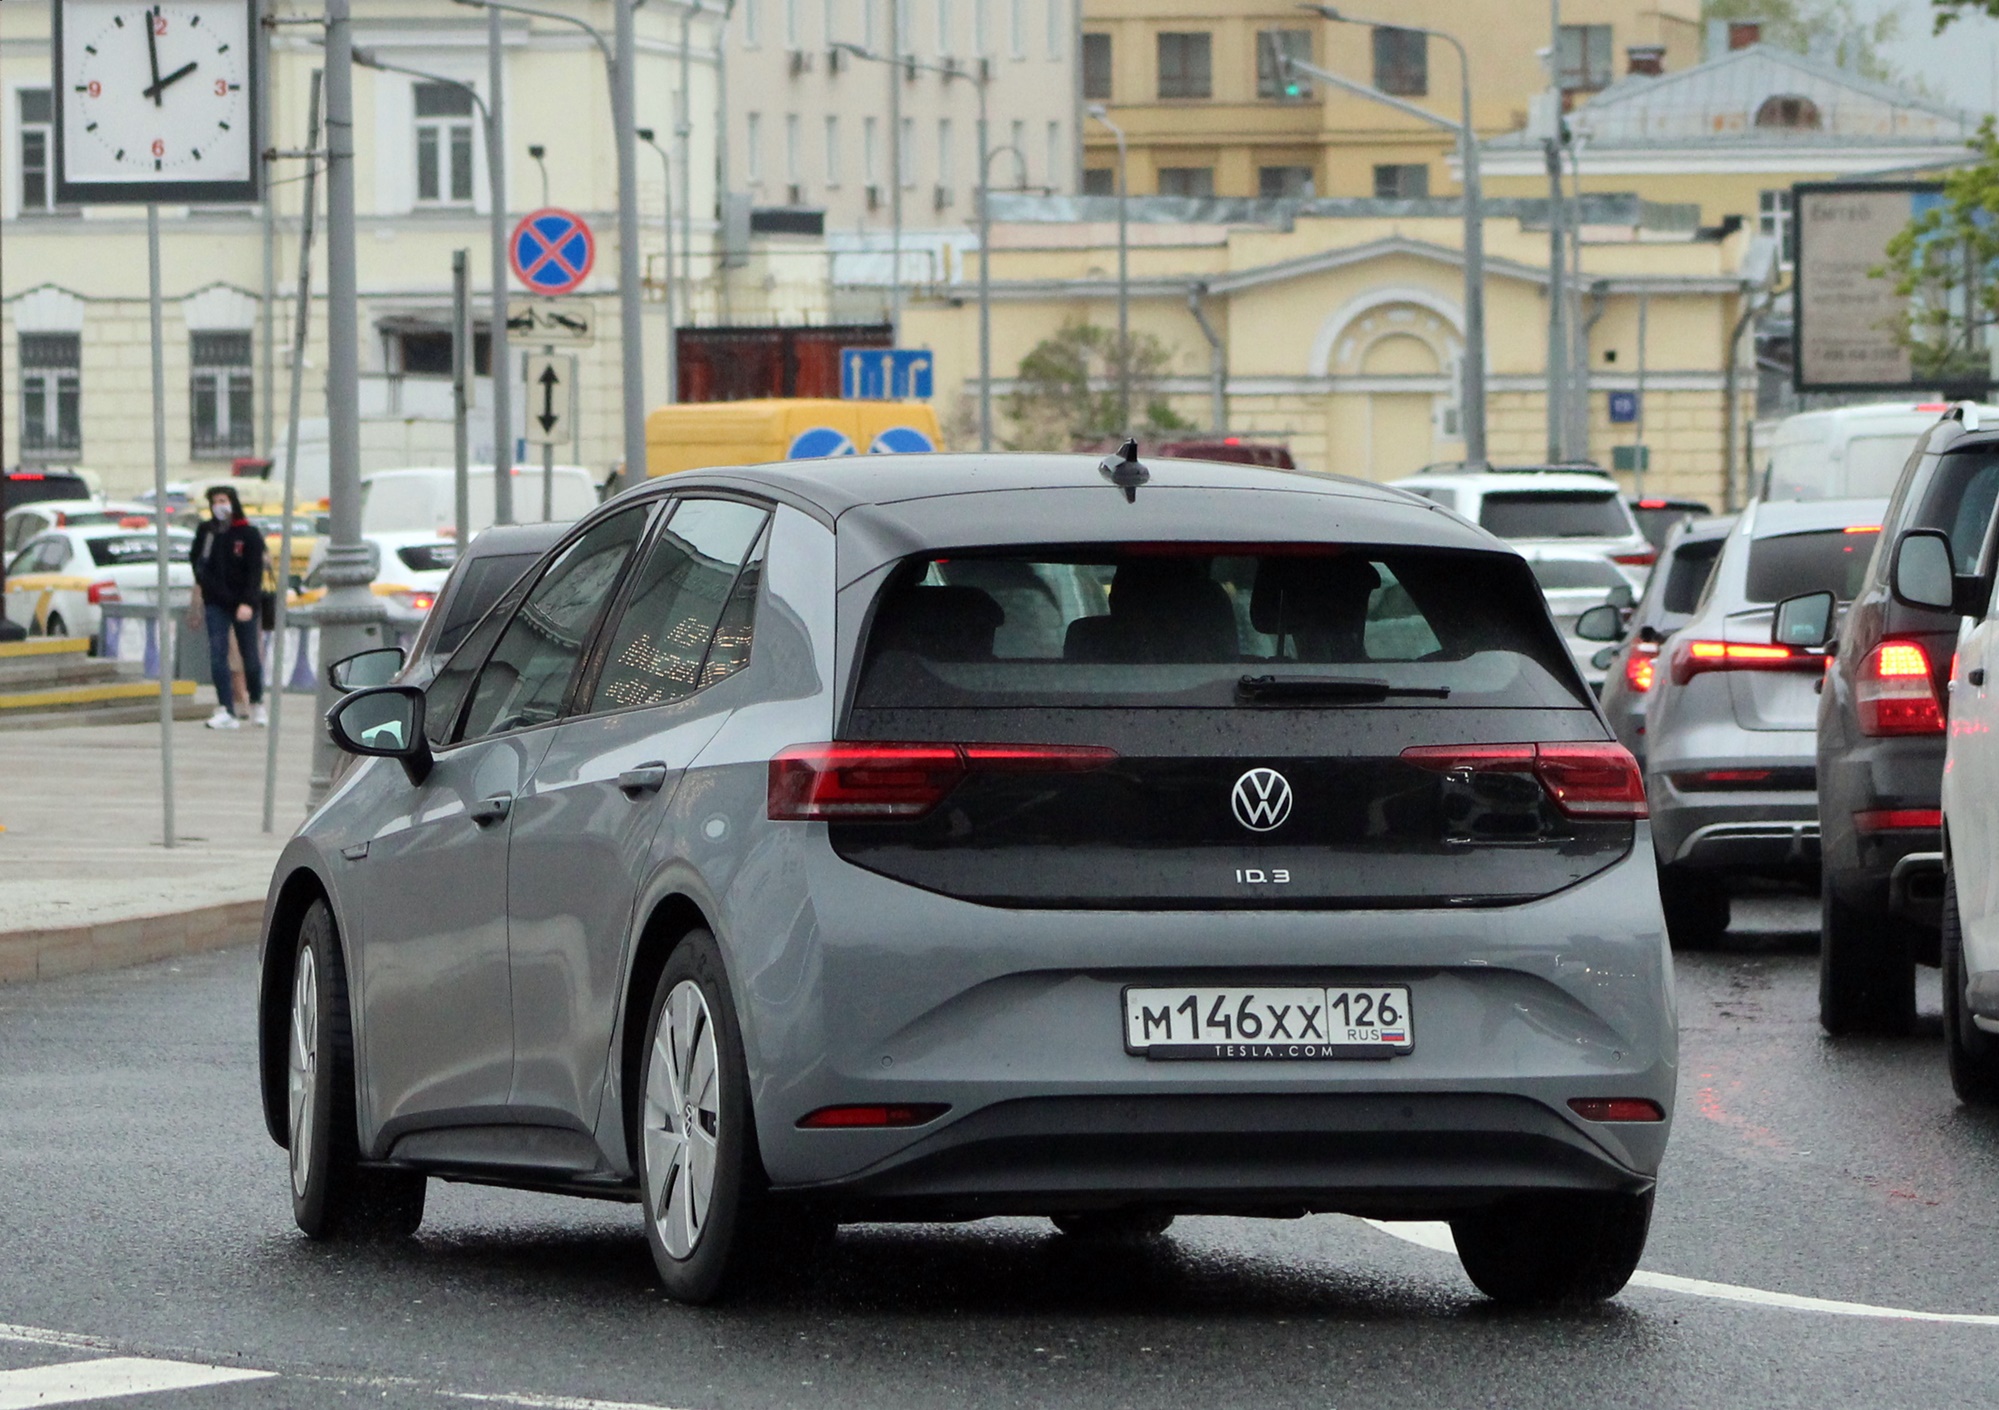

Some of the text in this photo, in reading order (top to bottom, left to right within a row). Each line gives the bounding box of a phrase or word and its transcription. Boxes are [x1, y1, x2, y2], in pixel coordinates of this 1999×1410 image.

[88, 81, 102, 98] 9
[214, 79, 227, 97] 3
[152, 139, 165, 157] 6
[1231, 767, 1293, 831] VW
[1235, 868, 1291, 884] ID.3
[1332, 992, 1399, 1027] 126
[1347, 1028, 1380, 1041] RUS
[1215, 1045, 1334, 1057] TESLA.COM
